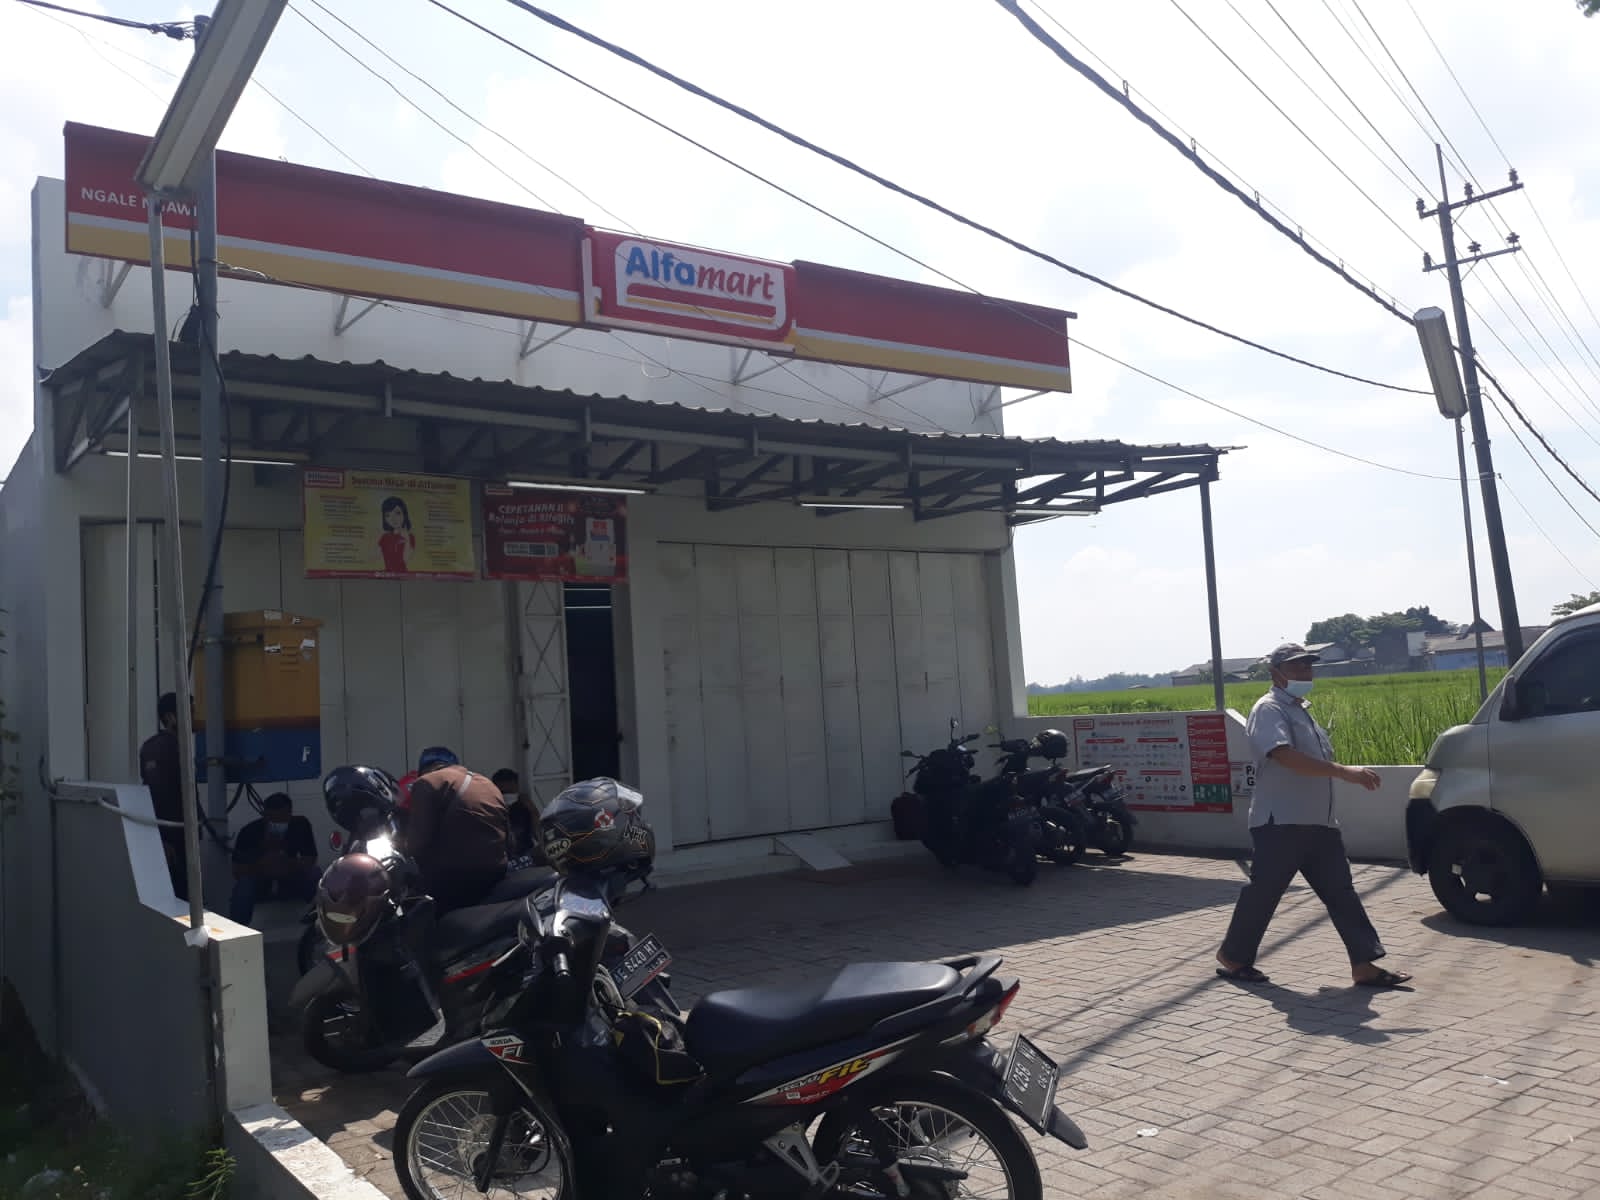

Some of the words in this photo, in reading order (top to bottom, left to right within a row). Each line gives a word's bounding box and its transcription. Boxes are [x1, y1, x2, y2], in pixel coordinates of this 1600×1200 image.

[81, 187, 137, 207] NGALE
[142, 196, 198, 217] NAWI
[625, 246, 775, 300] Alfamart
[489, 1037, 514, 1046] HONDA
